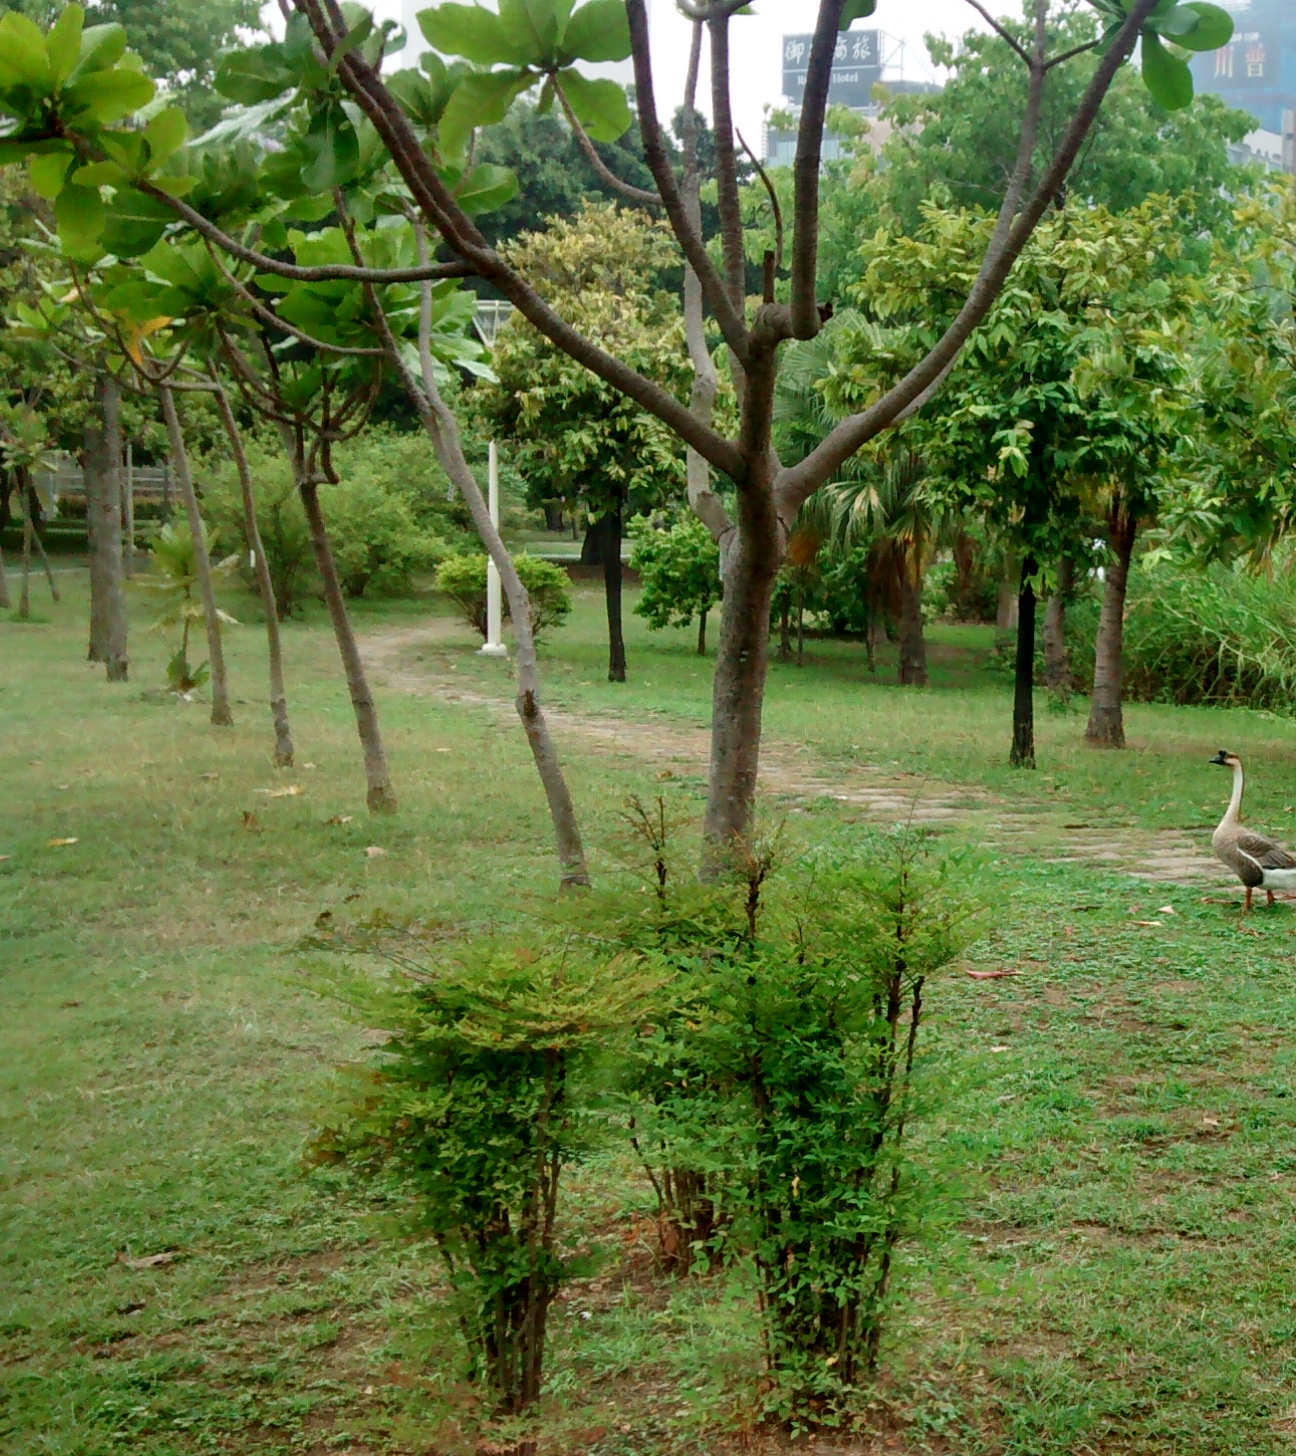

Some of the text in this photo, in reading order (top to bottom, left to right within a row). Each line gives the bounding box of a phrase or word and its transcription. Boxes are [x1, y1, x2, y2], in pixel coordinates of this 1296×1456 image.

[785, 35, 871, 64] 御商旅
[832, 72, 859, 83] Hotel
